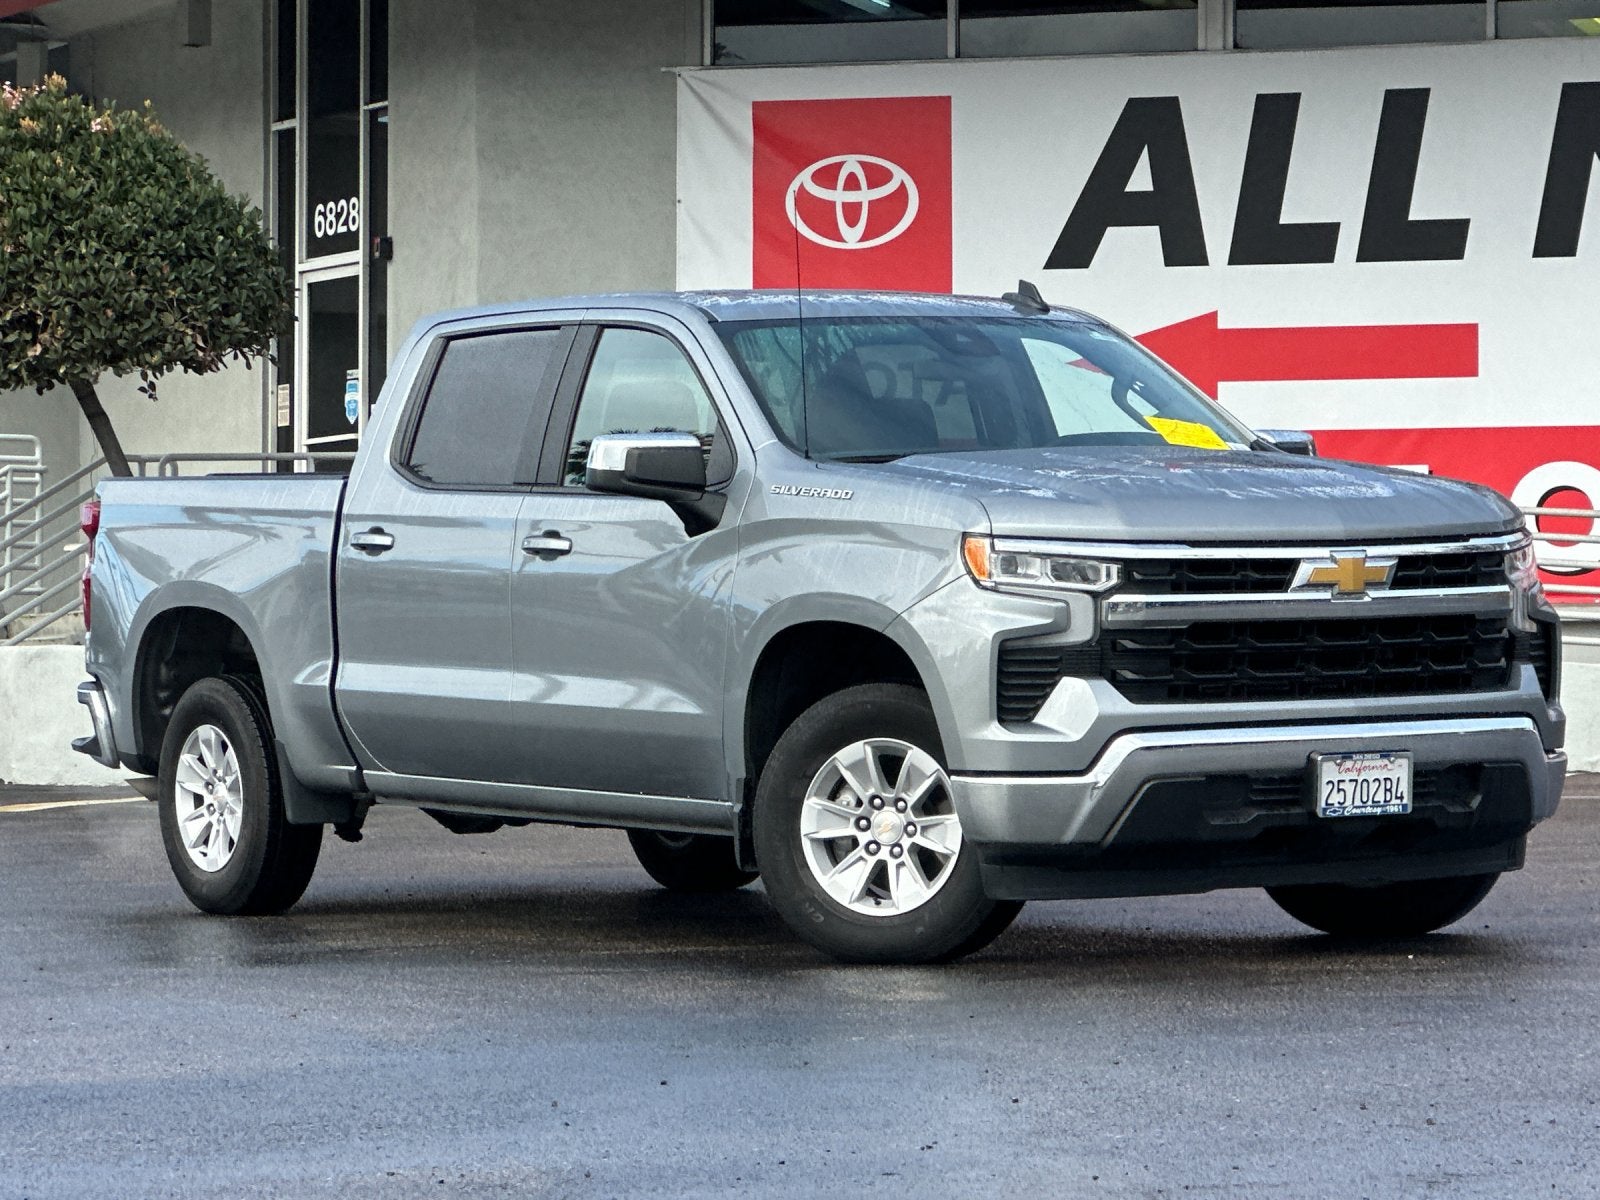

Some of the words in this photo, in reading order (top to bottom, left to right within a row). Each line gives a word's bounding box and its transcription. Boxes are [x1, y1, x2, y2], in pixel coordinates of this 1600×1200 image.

[1043, 88, 1471, 269] ALL
[314, 196, 359, 238] 6828
[770, 484, 854, 500] SILVERADO
[1338, 761, 1394, 777] California
[1325, 777, 1404, 806] 25702B4
[1344, 804, 1381, 816] Courtesy
